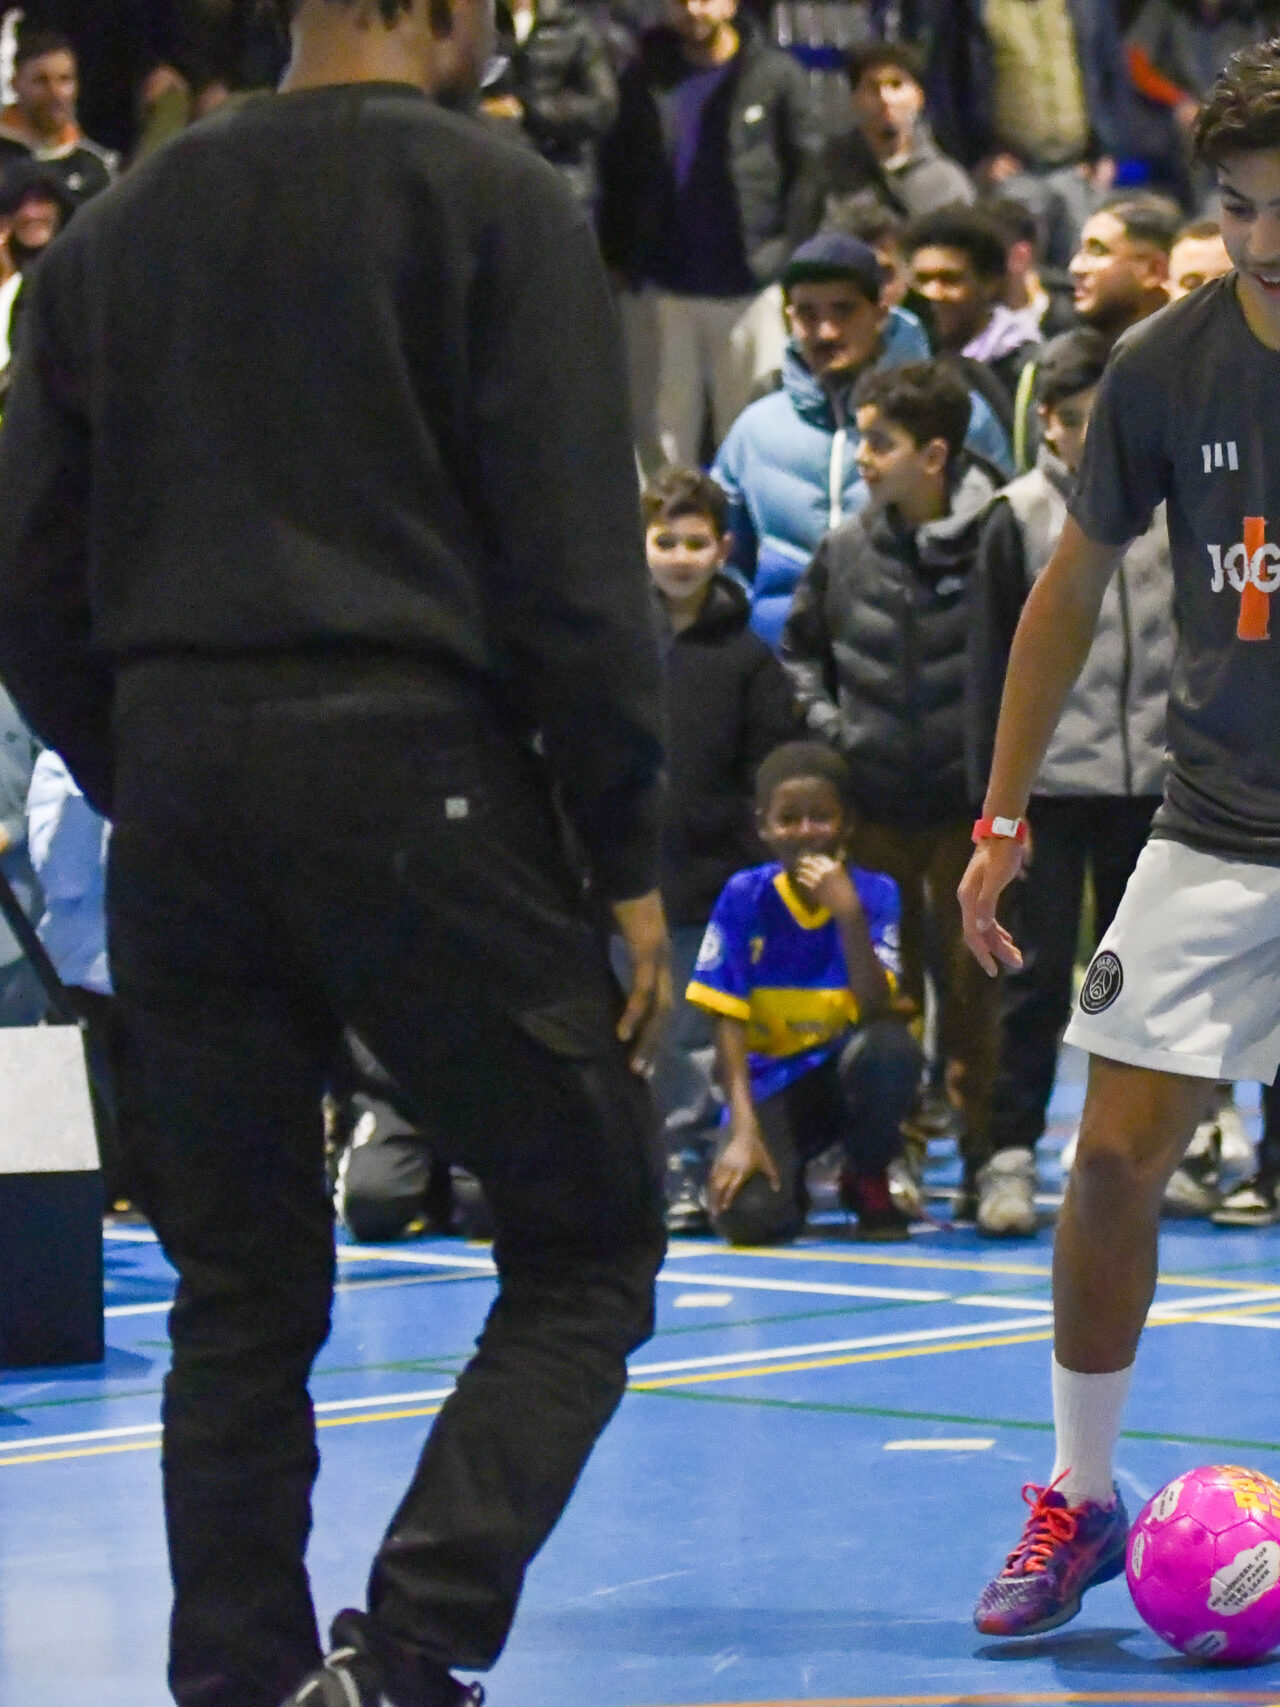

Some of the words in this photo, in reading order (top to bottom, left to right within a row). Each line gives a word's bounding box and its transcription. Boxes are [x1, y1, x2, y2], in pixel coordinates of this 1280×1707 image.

[1096, 958, 1118, 975] PARIS
[1210, 1596, 1222, 1607] NO
[1254, 1547, 1267, 1561] FOR
[1249, 1569, 1270, 1592] LEARN
